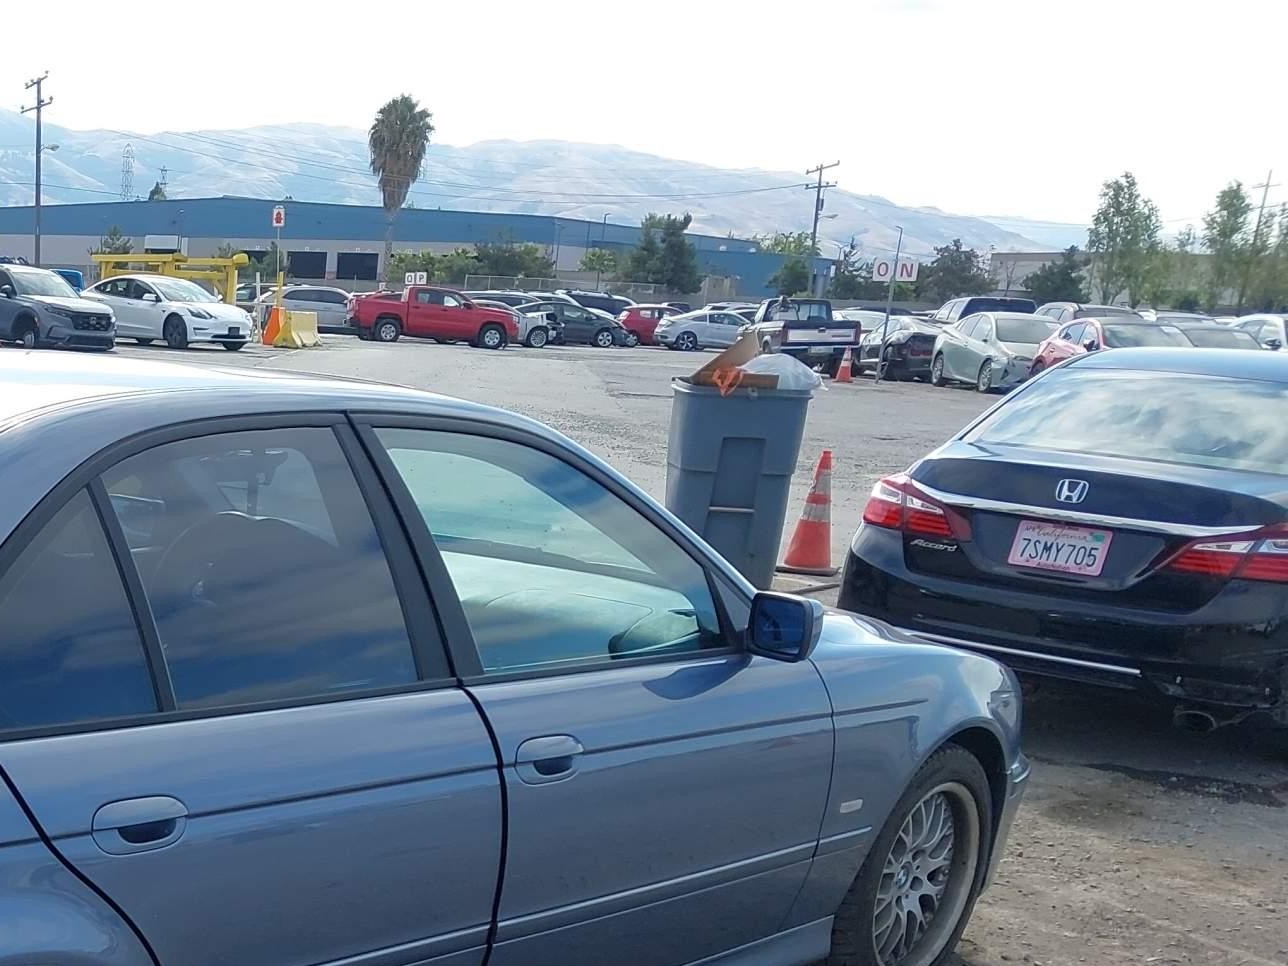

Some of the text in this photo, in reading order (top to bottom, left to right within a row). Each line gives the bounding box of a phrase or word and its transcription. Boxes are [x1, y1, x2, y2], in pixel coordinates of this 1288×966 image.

[877, 261, 889, 277] O
[899, 263, 914, 278] N
[1020, 537, 1099, 567] 7SMY705
